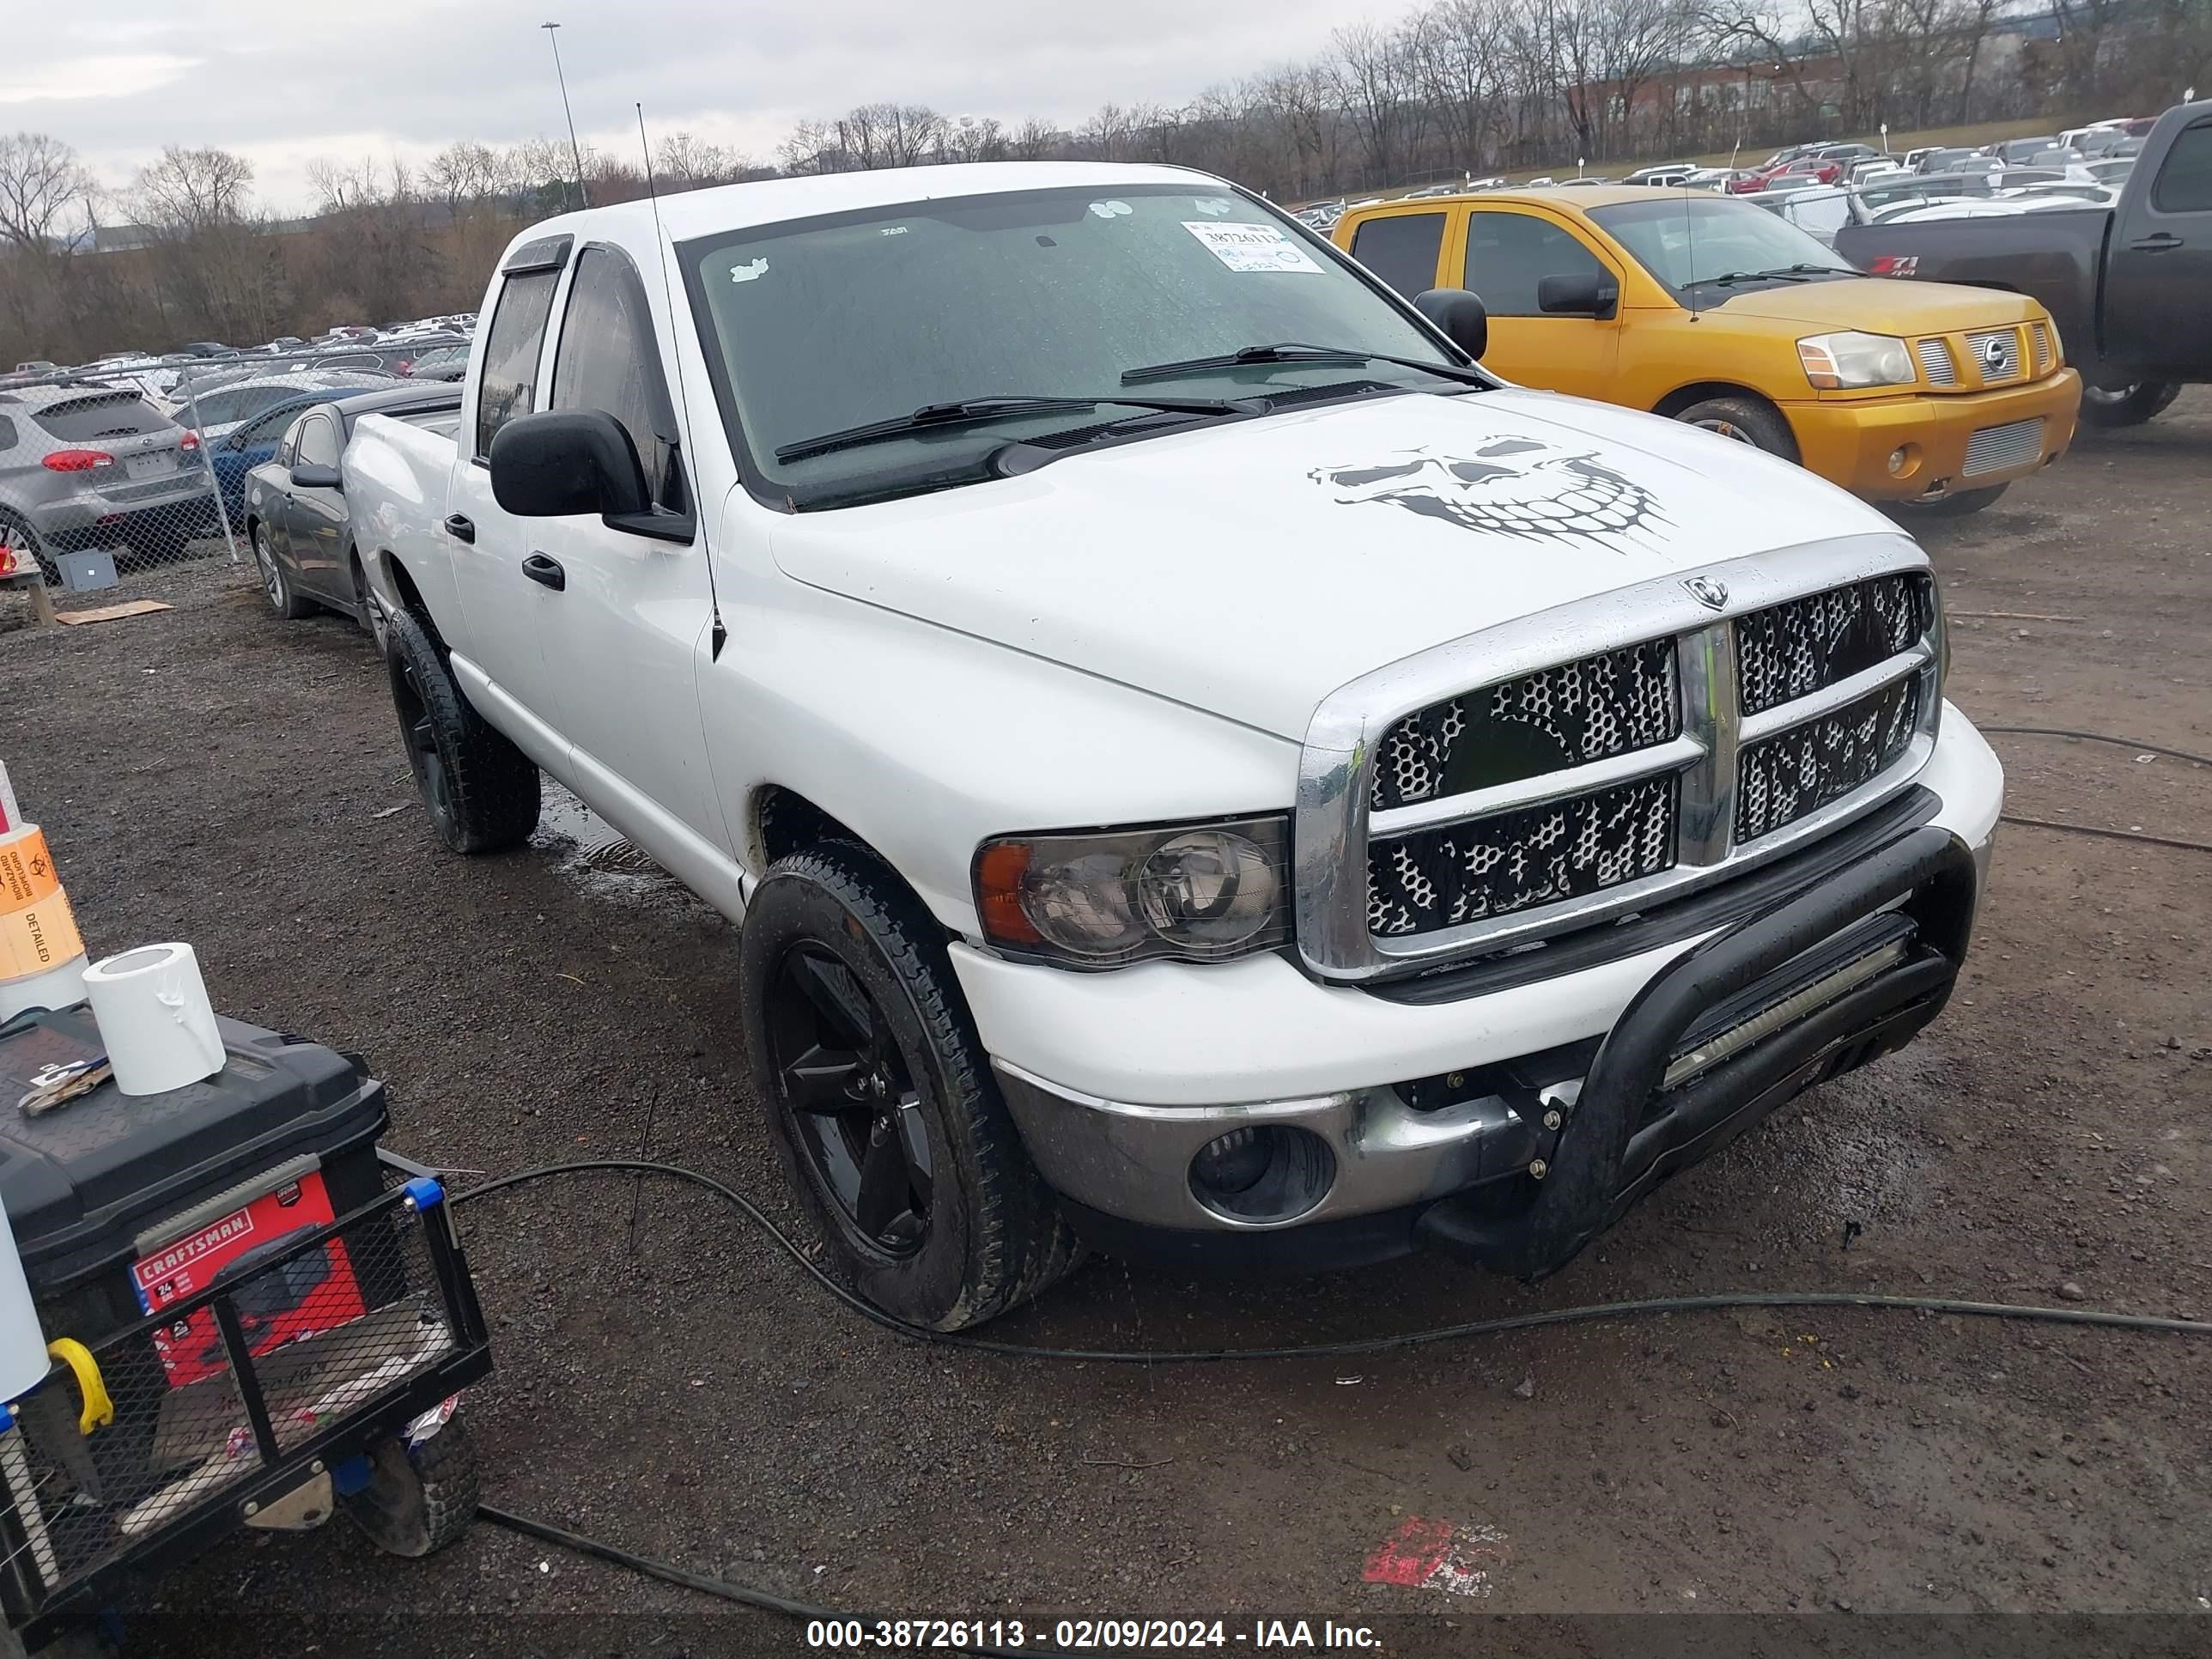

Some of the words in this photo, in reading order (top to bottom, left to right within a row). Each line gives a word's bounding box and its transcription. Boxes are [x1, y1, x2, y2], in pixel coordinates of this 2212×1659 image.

[1206, 233, 1280, 244] 38726113
[1869, 257, 1919, 273] Z71
[1, 854, 24, 901] BIOHAZARD
[26, 913, 50, 963] DETAILED
[143, 1216, 245, 1280] CRAFTSMAN
[158, 1283, 172, 1296] 24
